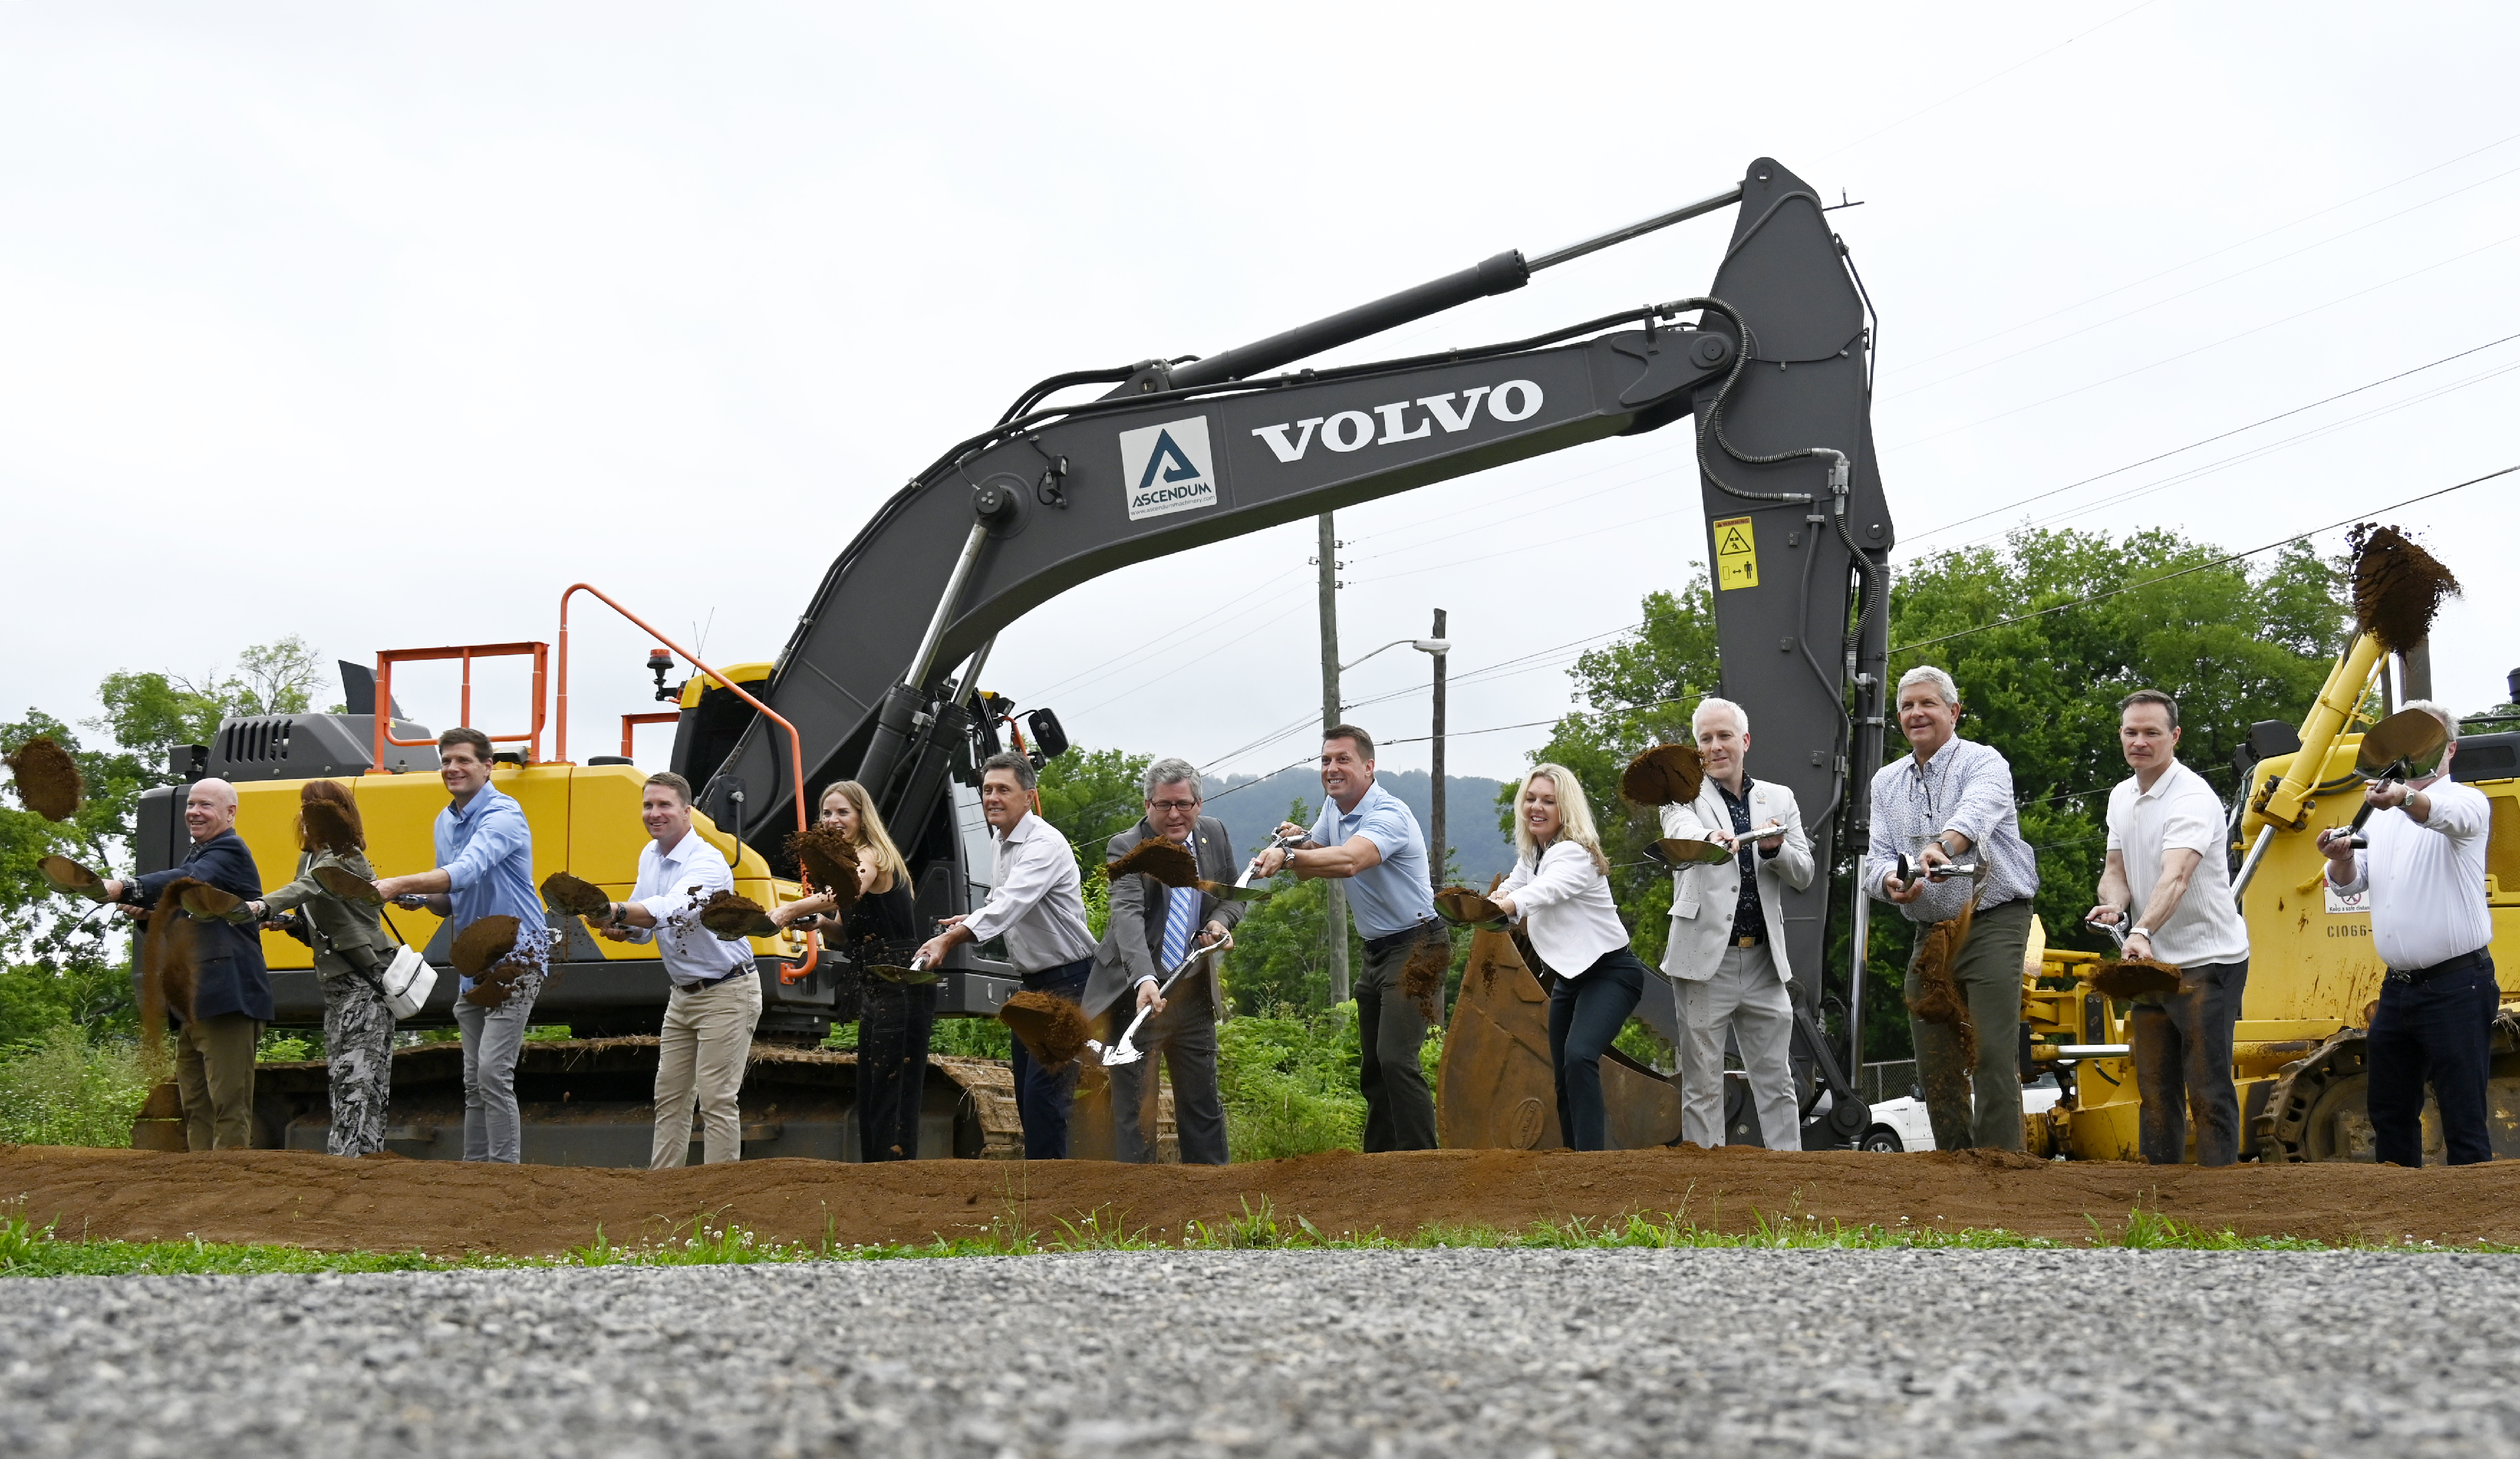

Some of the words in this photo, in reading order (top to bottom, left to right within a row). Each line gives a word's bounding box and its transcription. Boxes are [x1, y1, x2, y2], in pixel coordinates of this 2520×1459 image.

[1252, 379, 1544, 463] VOLVO
[1131, 495, 1216, 516] www.ascendummachinery.com
[1132, 482, 1212, 507] ASCENDUM
